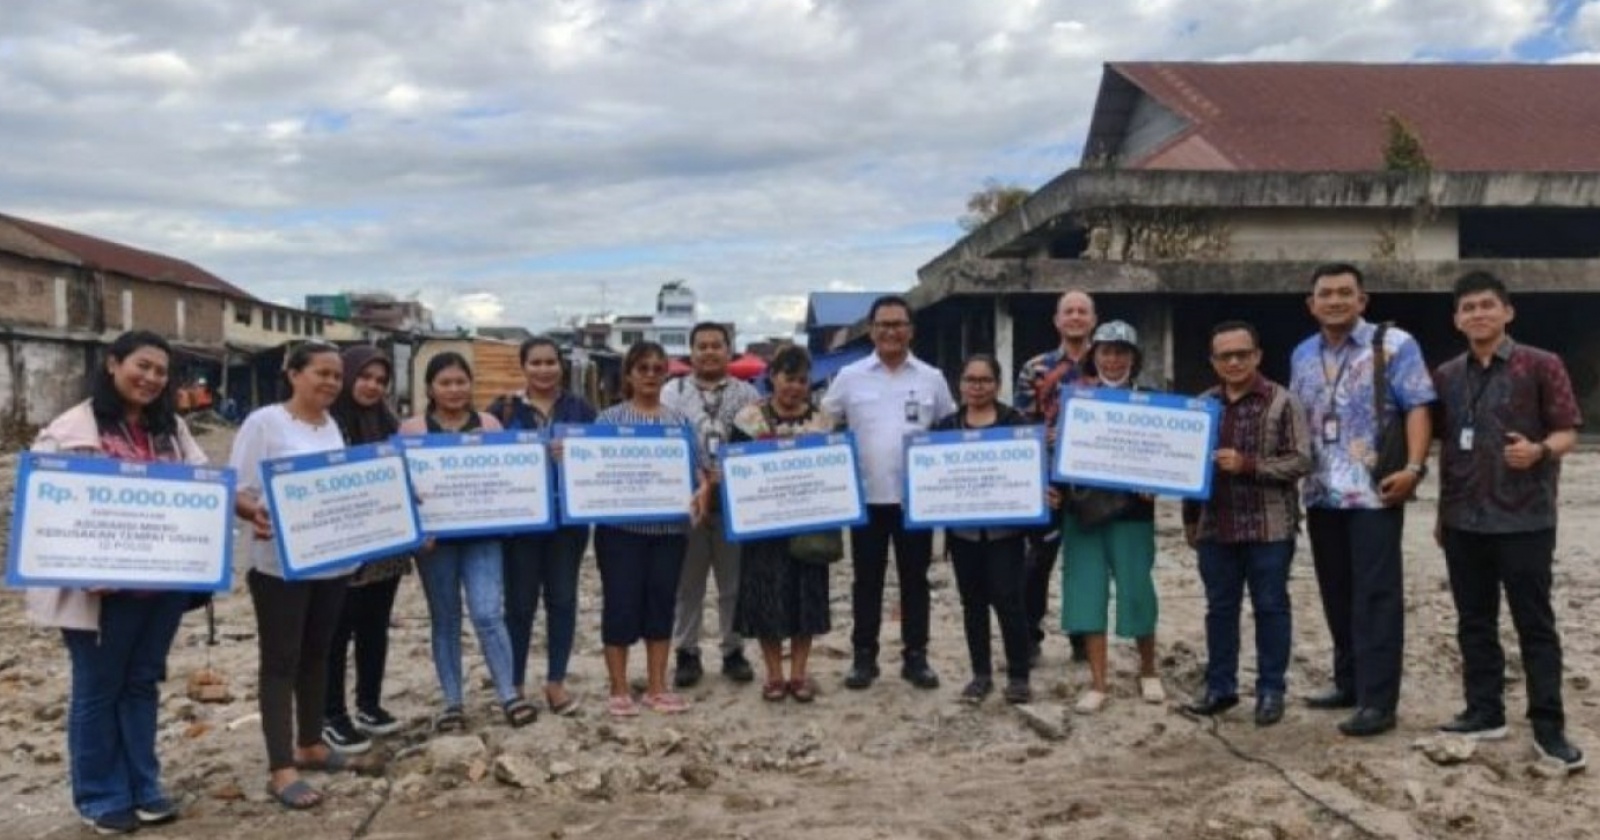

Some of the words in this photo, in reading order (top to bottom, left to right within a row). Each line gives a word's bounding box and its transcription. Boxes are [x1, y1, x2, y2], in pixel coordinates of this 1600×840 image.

[1073, 407, 1099, 423] Rp.
[1106, 410, 1205, 432] 10.000.000
[439, 452, 539, 470] 10.000.000
[570, 445, 596, 461] Rp.
[601, 445, 684, 458] 10.000.000
[914, 453, 939, 467] Rp.
[942, 448, 1035, 463] 10.000.000
[762, 454, 847, 472] 10.000.000
[284, 484, 312, 499] Rp.
[315, 467, 397, 493] 5.000.000
[37, 482, 79, 505] Rp.
[86, 485, 219, 509] 10.000.000
